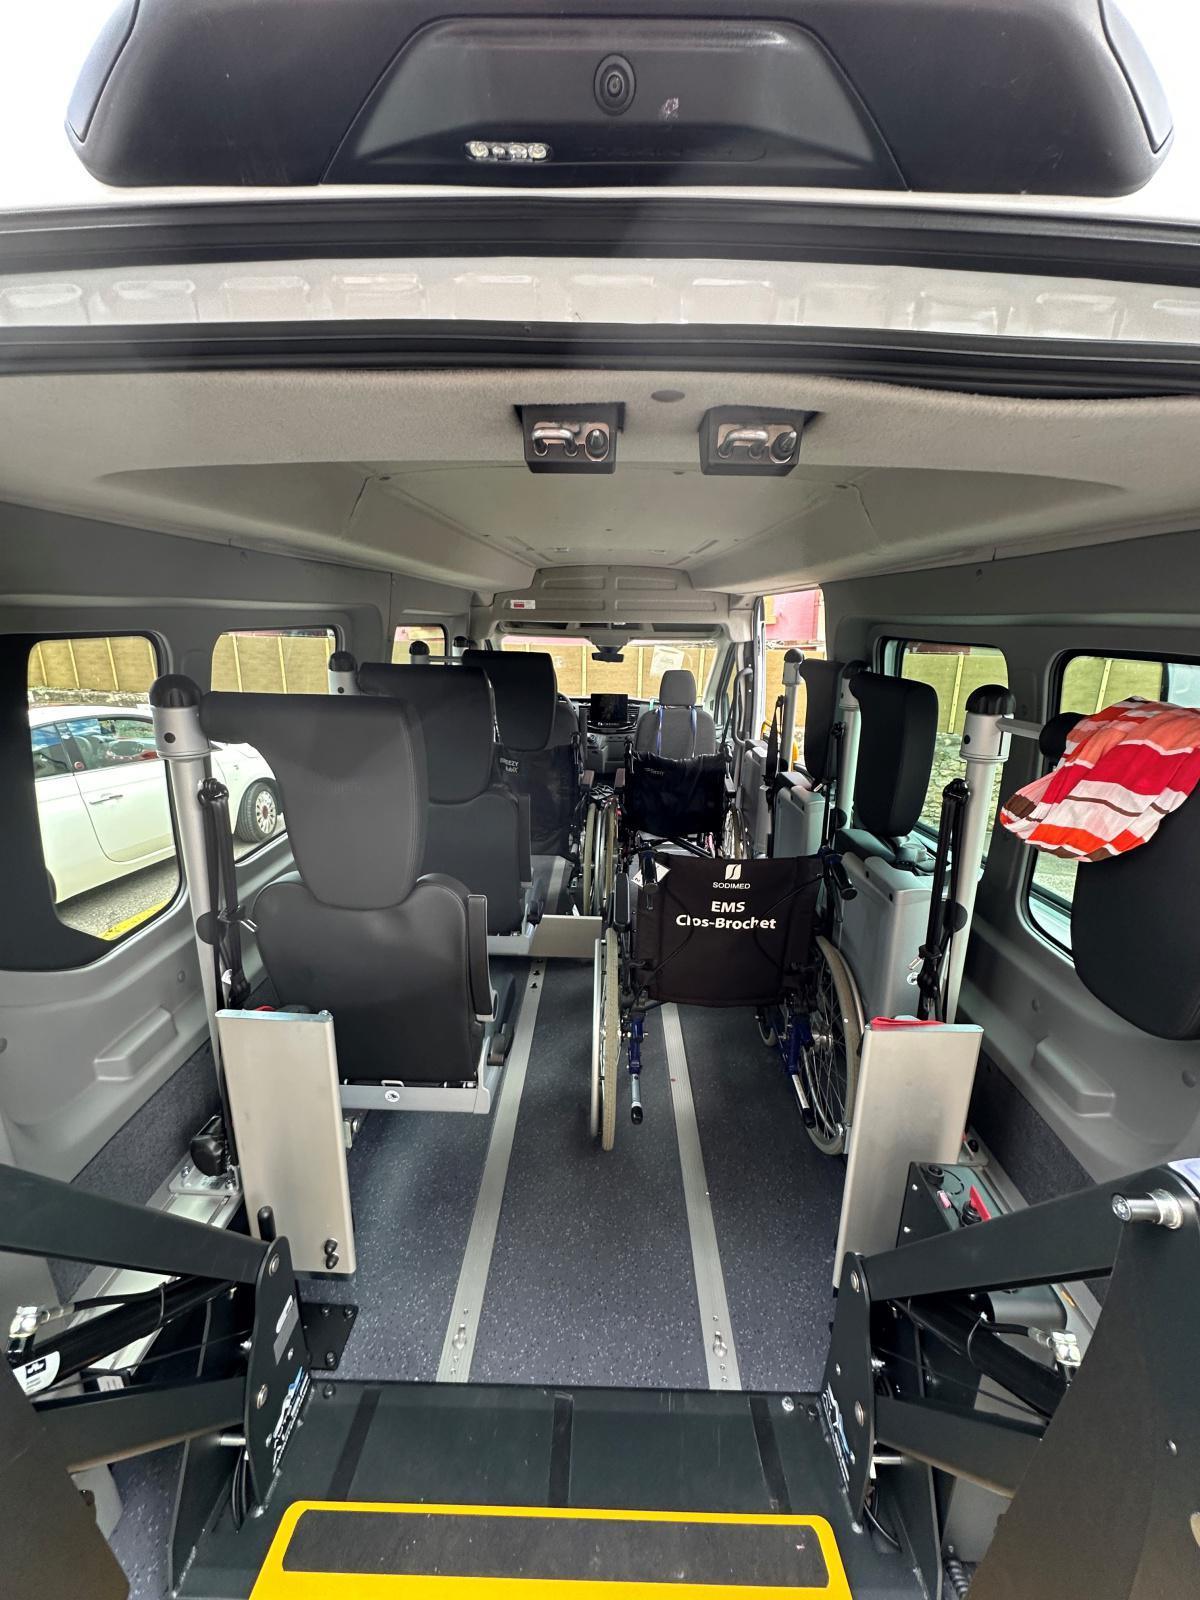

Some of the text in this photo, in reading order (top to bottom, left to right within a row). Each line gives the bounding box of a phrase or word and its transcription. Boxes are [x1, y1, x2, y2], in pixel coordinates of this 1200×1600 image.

[712, 881, 751, 890] SODIMED
[711, 900, 746, 913] EMS
[675, 914, 777, 930] Clos-Brochet
